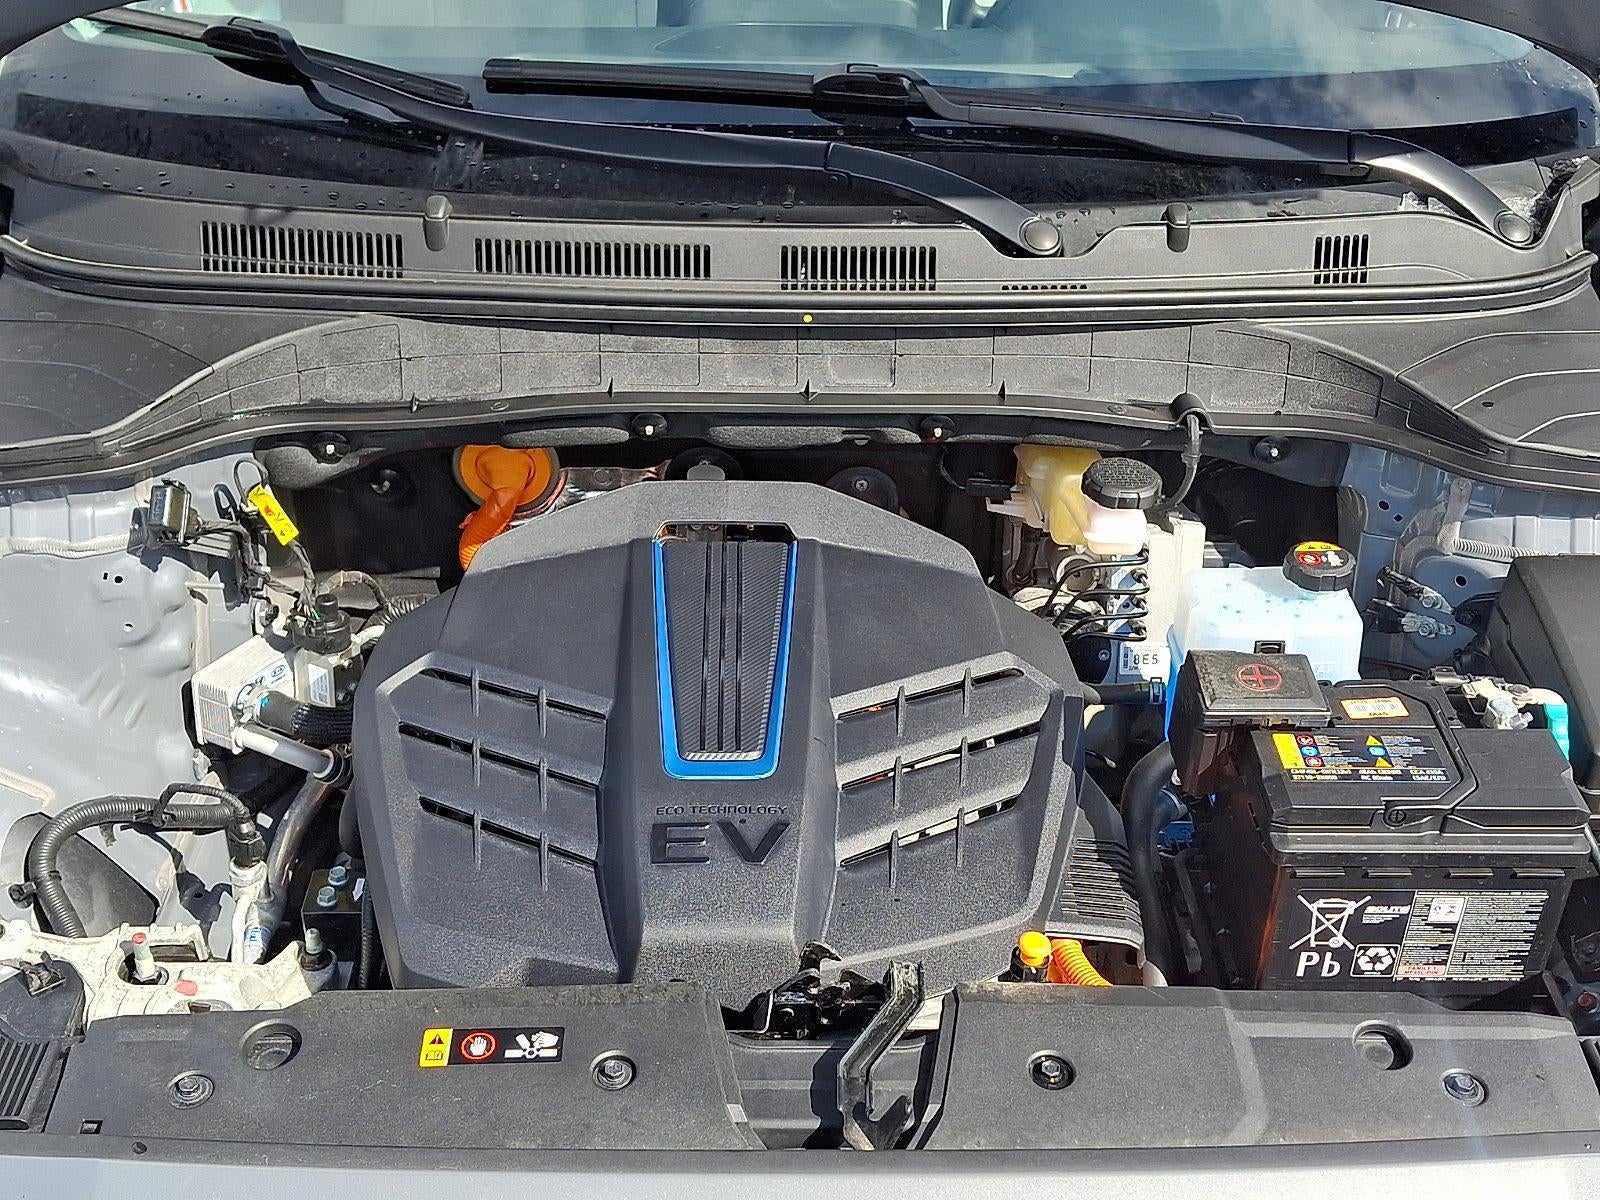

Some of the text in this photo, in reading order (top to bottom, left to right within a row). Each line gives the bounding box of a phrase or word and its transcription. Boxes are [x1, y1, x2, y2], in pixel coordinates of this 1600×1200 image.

[1133, 653, 1158, 665] 8E5
[656, 804, 788, 815] ECO TECHNOLOGY
[651, 821, 791, 865] EV
[1296, 951, 1341, 977] Pb
